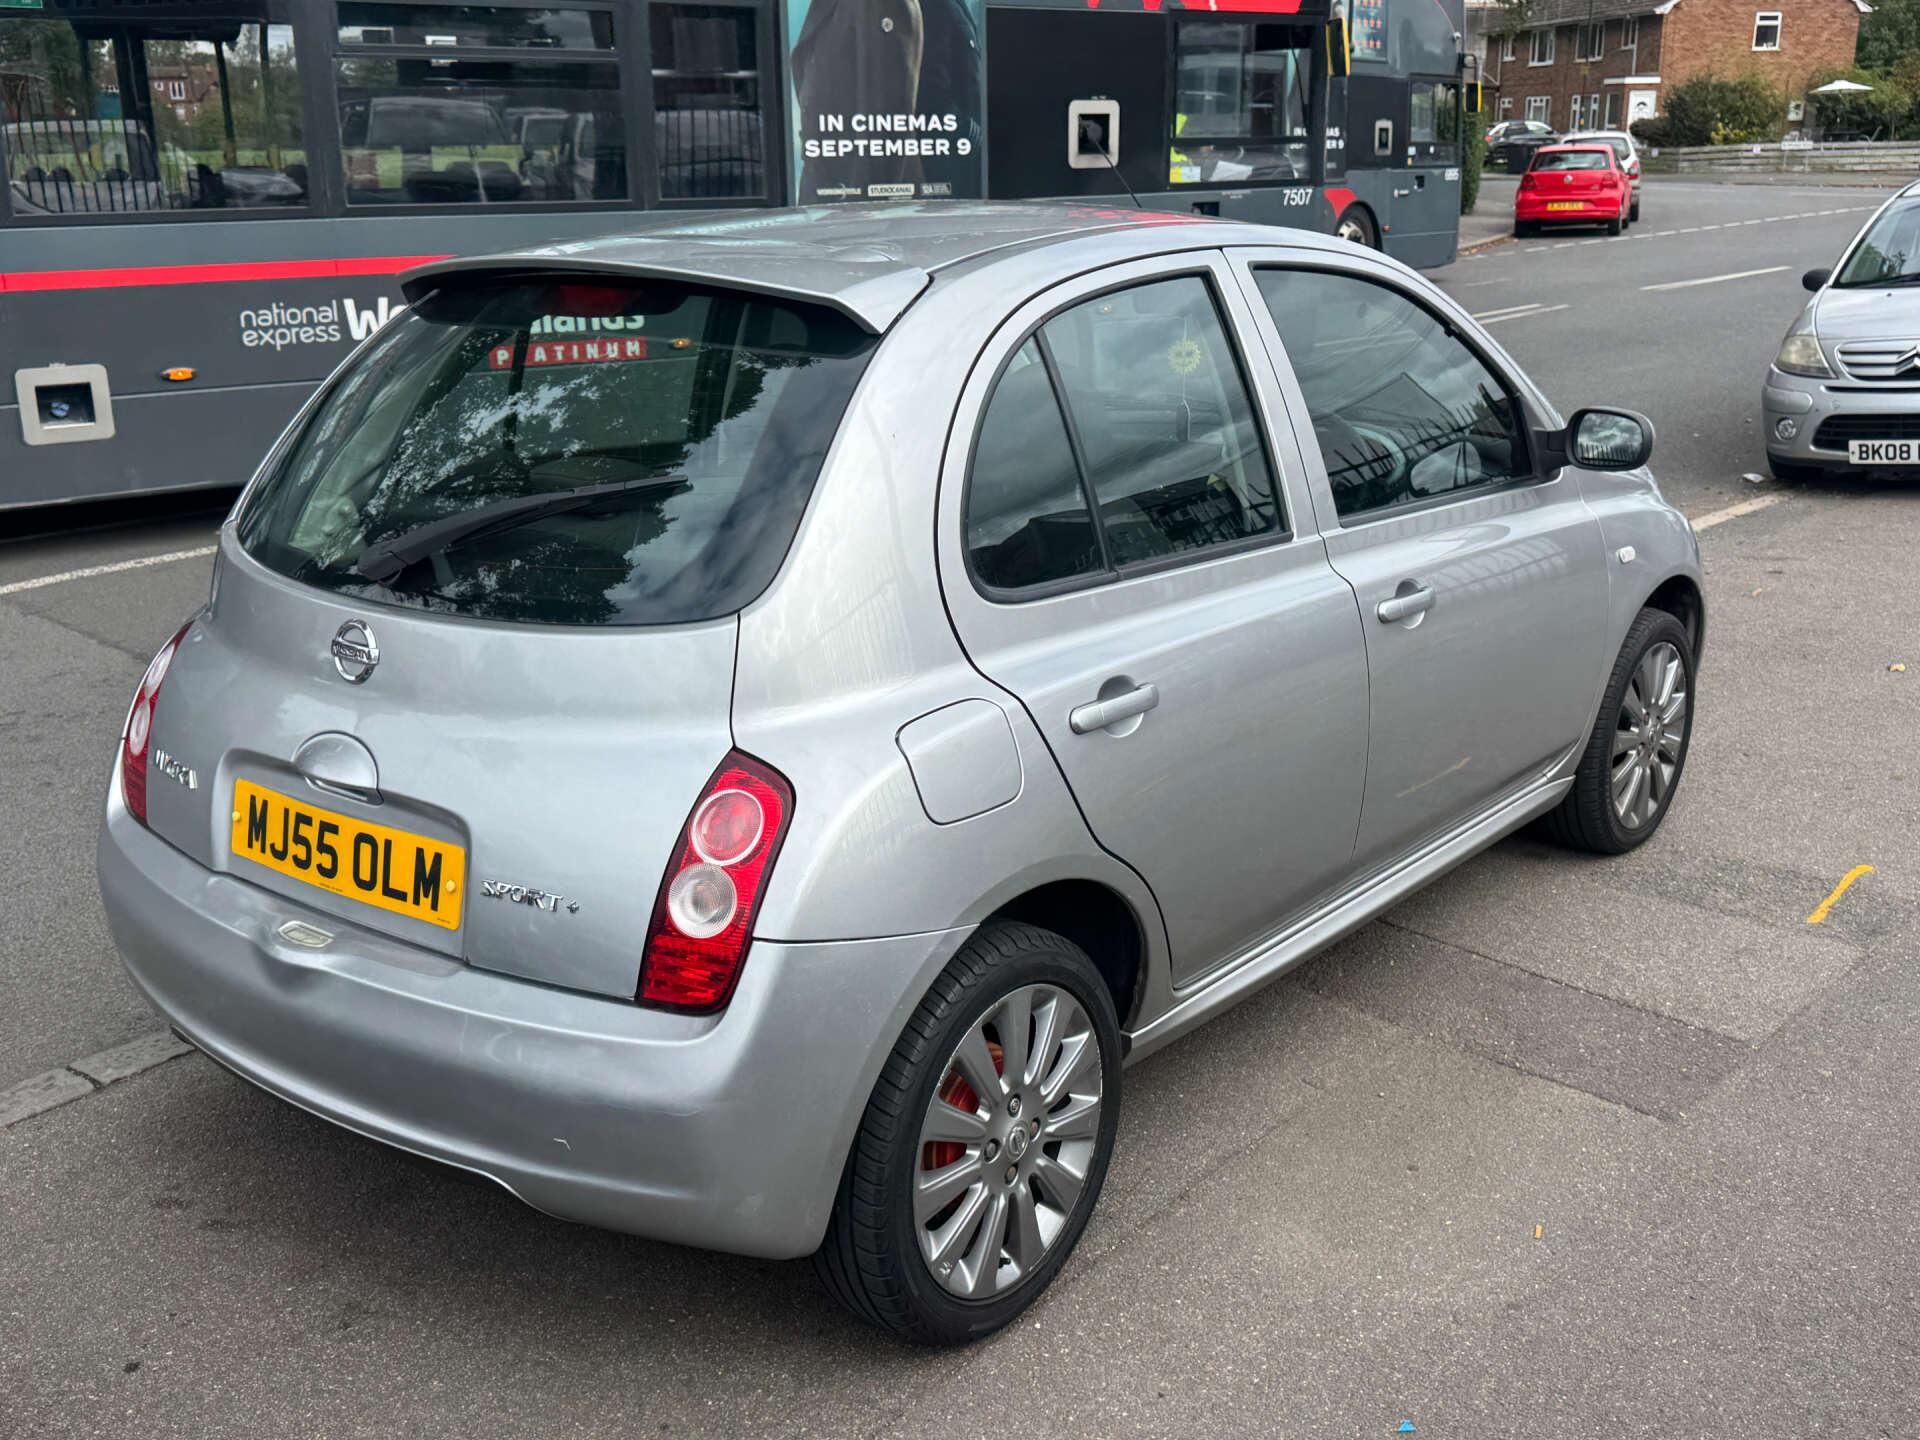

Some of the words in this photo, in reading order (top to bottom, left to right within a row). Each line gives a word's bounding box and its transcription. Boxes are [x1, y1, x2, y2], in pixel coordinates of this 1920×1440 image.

[819, 114, 844, 132] IN
[851, 114, 958, 132] CINEMAS
[805, 139, 950, 157] SEPTEMBER
[956, 138, 972, 156] 9
[1283, 189, 1313, 206] 7507
[240, 299, 339, 328] national
[242, 325, 341, 351] express
[496, 340, 641, 366] PATINUM
[1858, 443, 1911, 461] BK08
[247, 794, 339, 880] MJ55
[352, 832, 442, 912] OLM
[481, 879, 563, 912] SPORT
